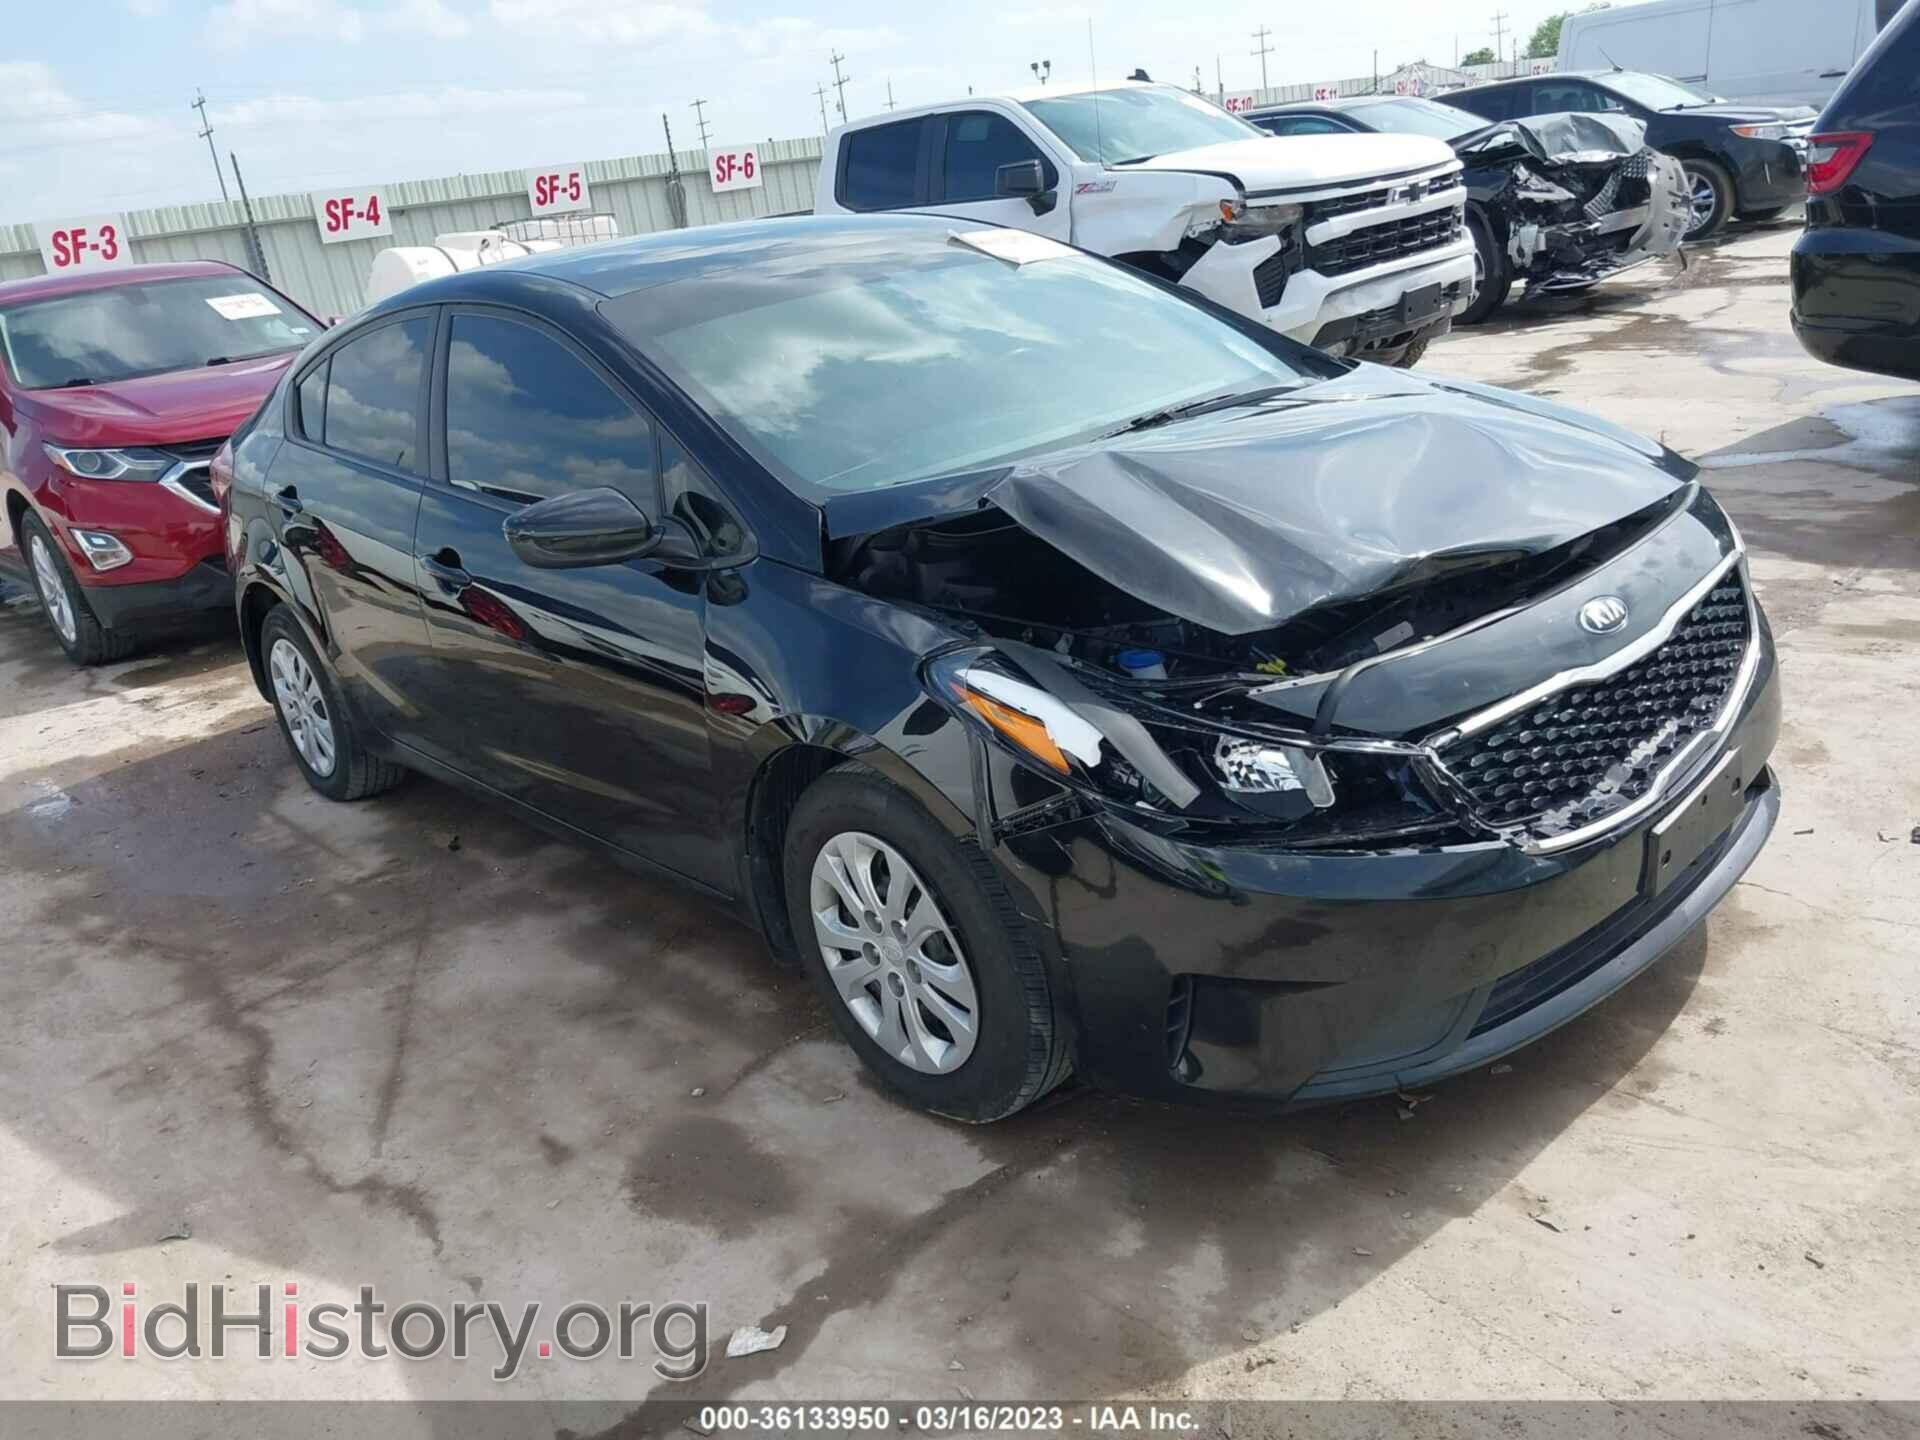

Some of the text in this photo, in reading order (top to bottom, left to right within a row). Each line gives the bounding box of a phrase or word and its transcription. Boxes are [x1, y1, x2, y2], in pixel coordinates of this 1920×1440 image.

[715, 152, 754, 183] SF-6
[535, 172, 581, 207] SF-5
[324, 195, 381, 233] SF-4
[51, 225, 118, 267] SF-3
[1583, 598, 1626, 629] KIA
